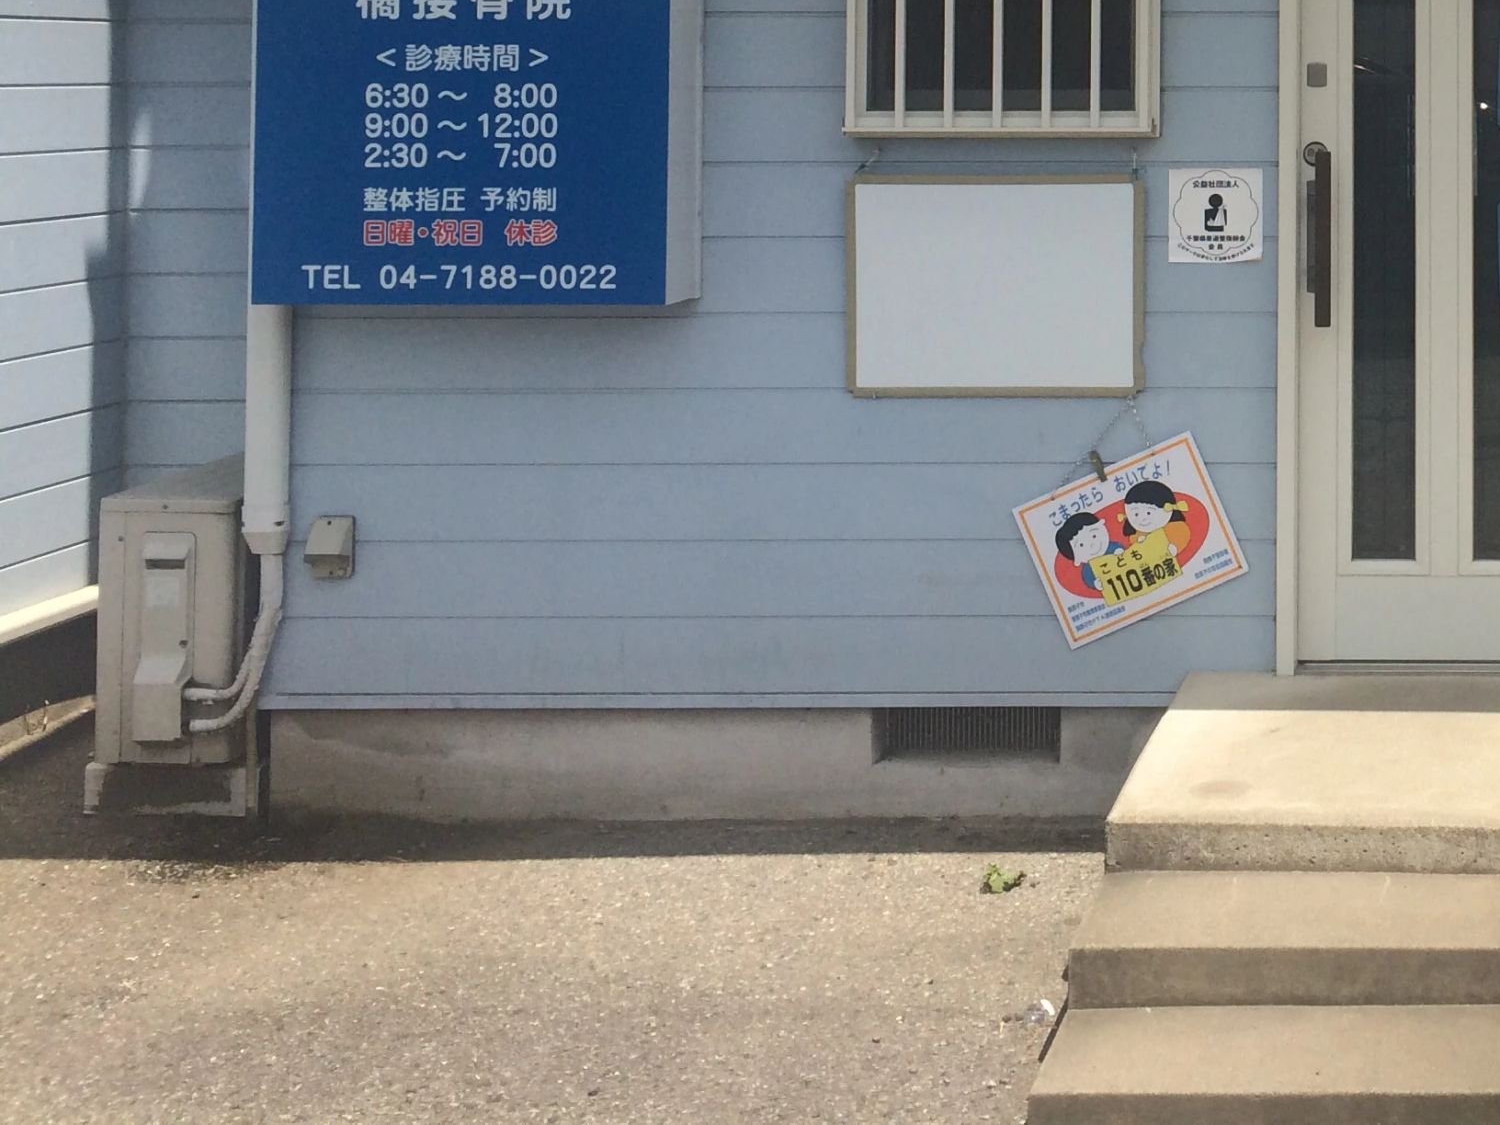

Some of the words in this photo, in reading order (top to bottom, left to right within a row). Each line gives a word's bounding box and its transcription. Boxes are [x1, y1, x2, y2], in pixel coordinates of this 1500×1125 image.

[363, 187, 466, 212] 整体指圧
[480, 187, 557, 212] 予約制
[363, 219, 484, 246] 日曜・祝日
[504, 219, 558, 246] 休診
[302, 265, 361, 290] TEL
[1048, 487, 1104, 527] こまったら
[1099, 550, 1143, 575] こども
[1106, 557, 1179, 601] 110番の家
